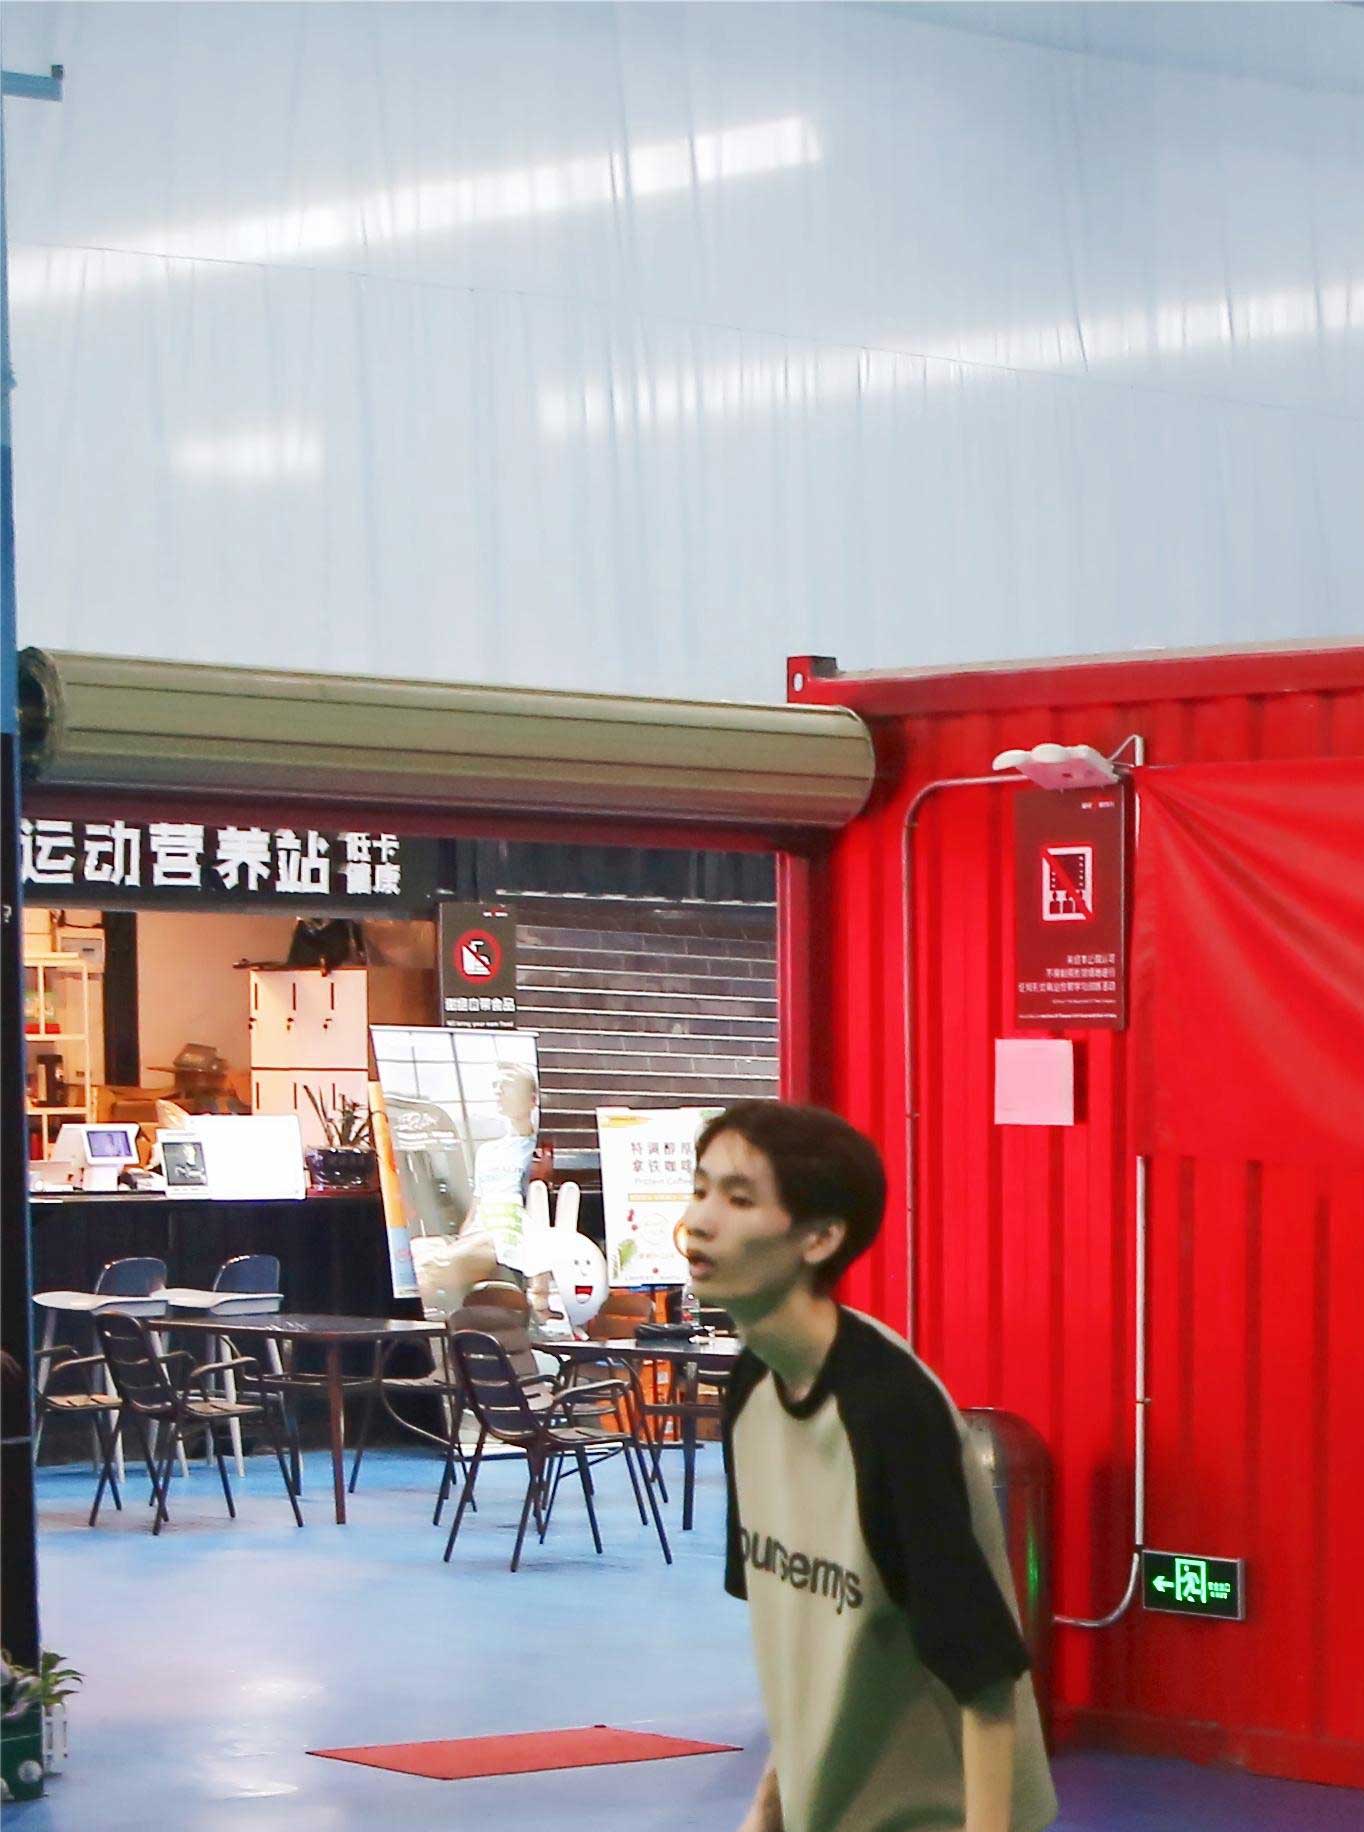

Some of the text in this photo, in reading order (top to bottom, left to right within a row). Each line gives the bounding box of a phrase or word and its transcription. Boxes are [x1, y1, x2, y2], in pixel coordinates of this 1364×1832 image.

[20, 818, 332, 895] 运动营养站
